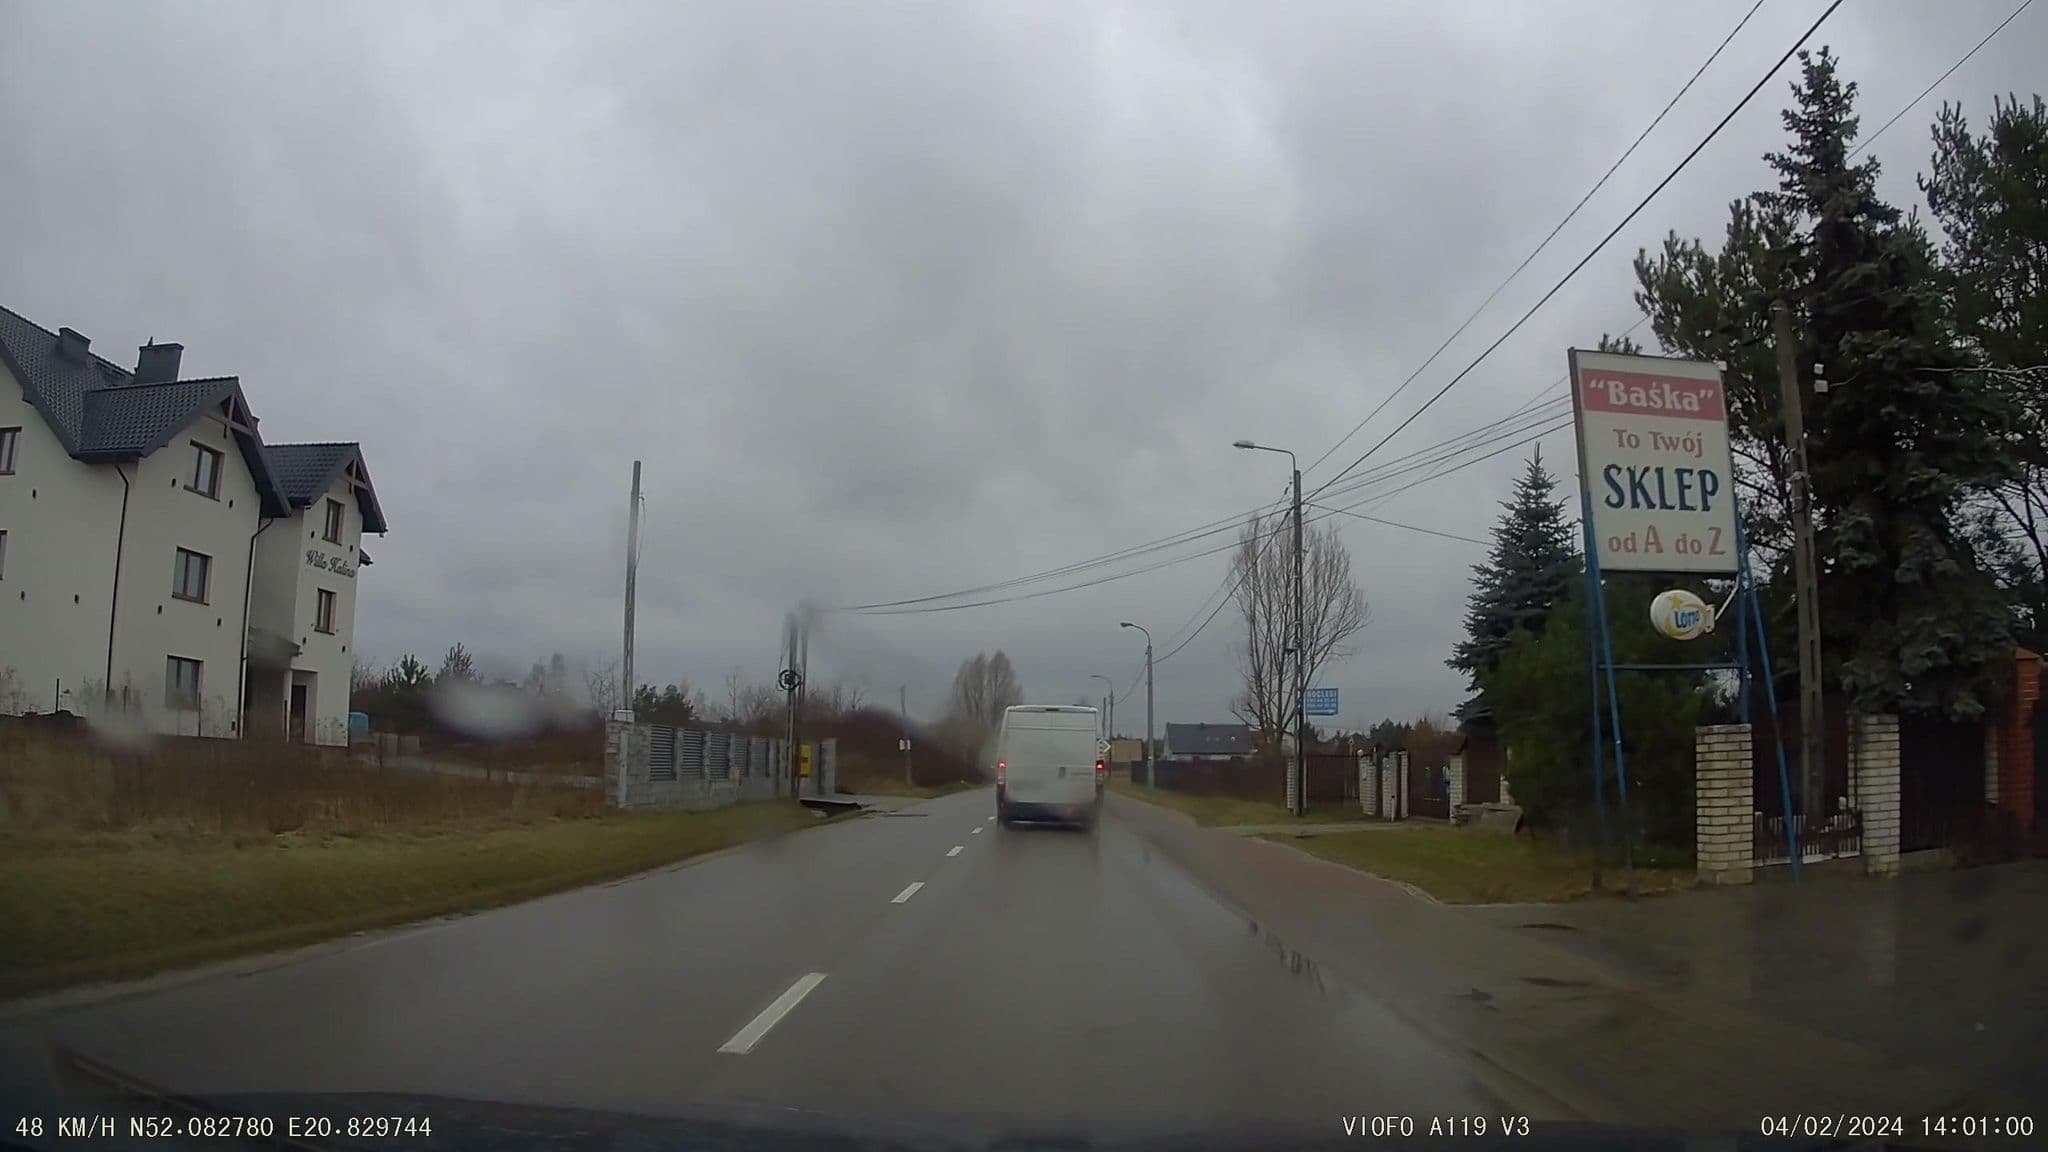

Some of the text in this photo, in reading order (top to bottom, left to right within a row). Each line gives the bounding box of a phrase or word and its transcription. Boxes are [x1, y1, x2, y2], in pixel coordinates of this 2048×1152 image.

[1613, 429, 1703, 458] To Twój
[1603, 464, 1719, 512] SKLEP
[1608, 525, 1726, 555] od A do Z
